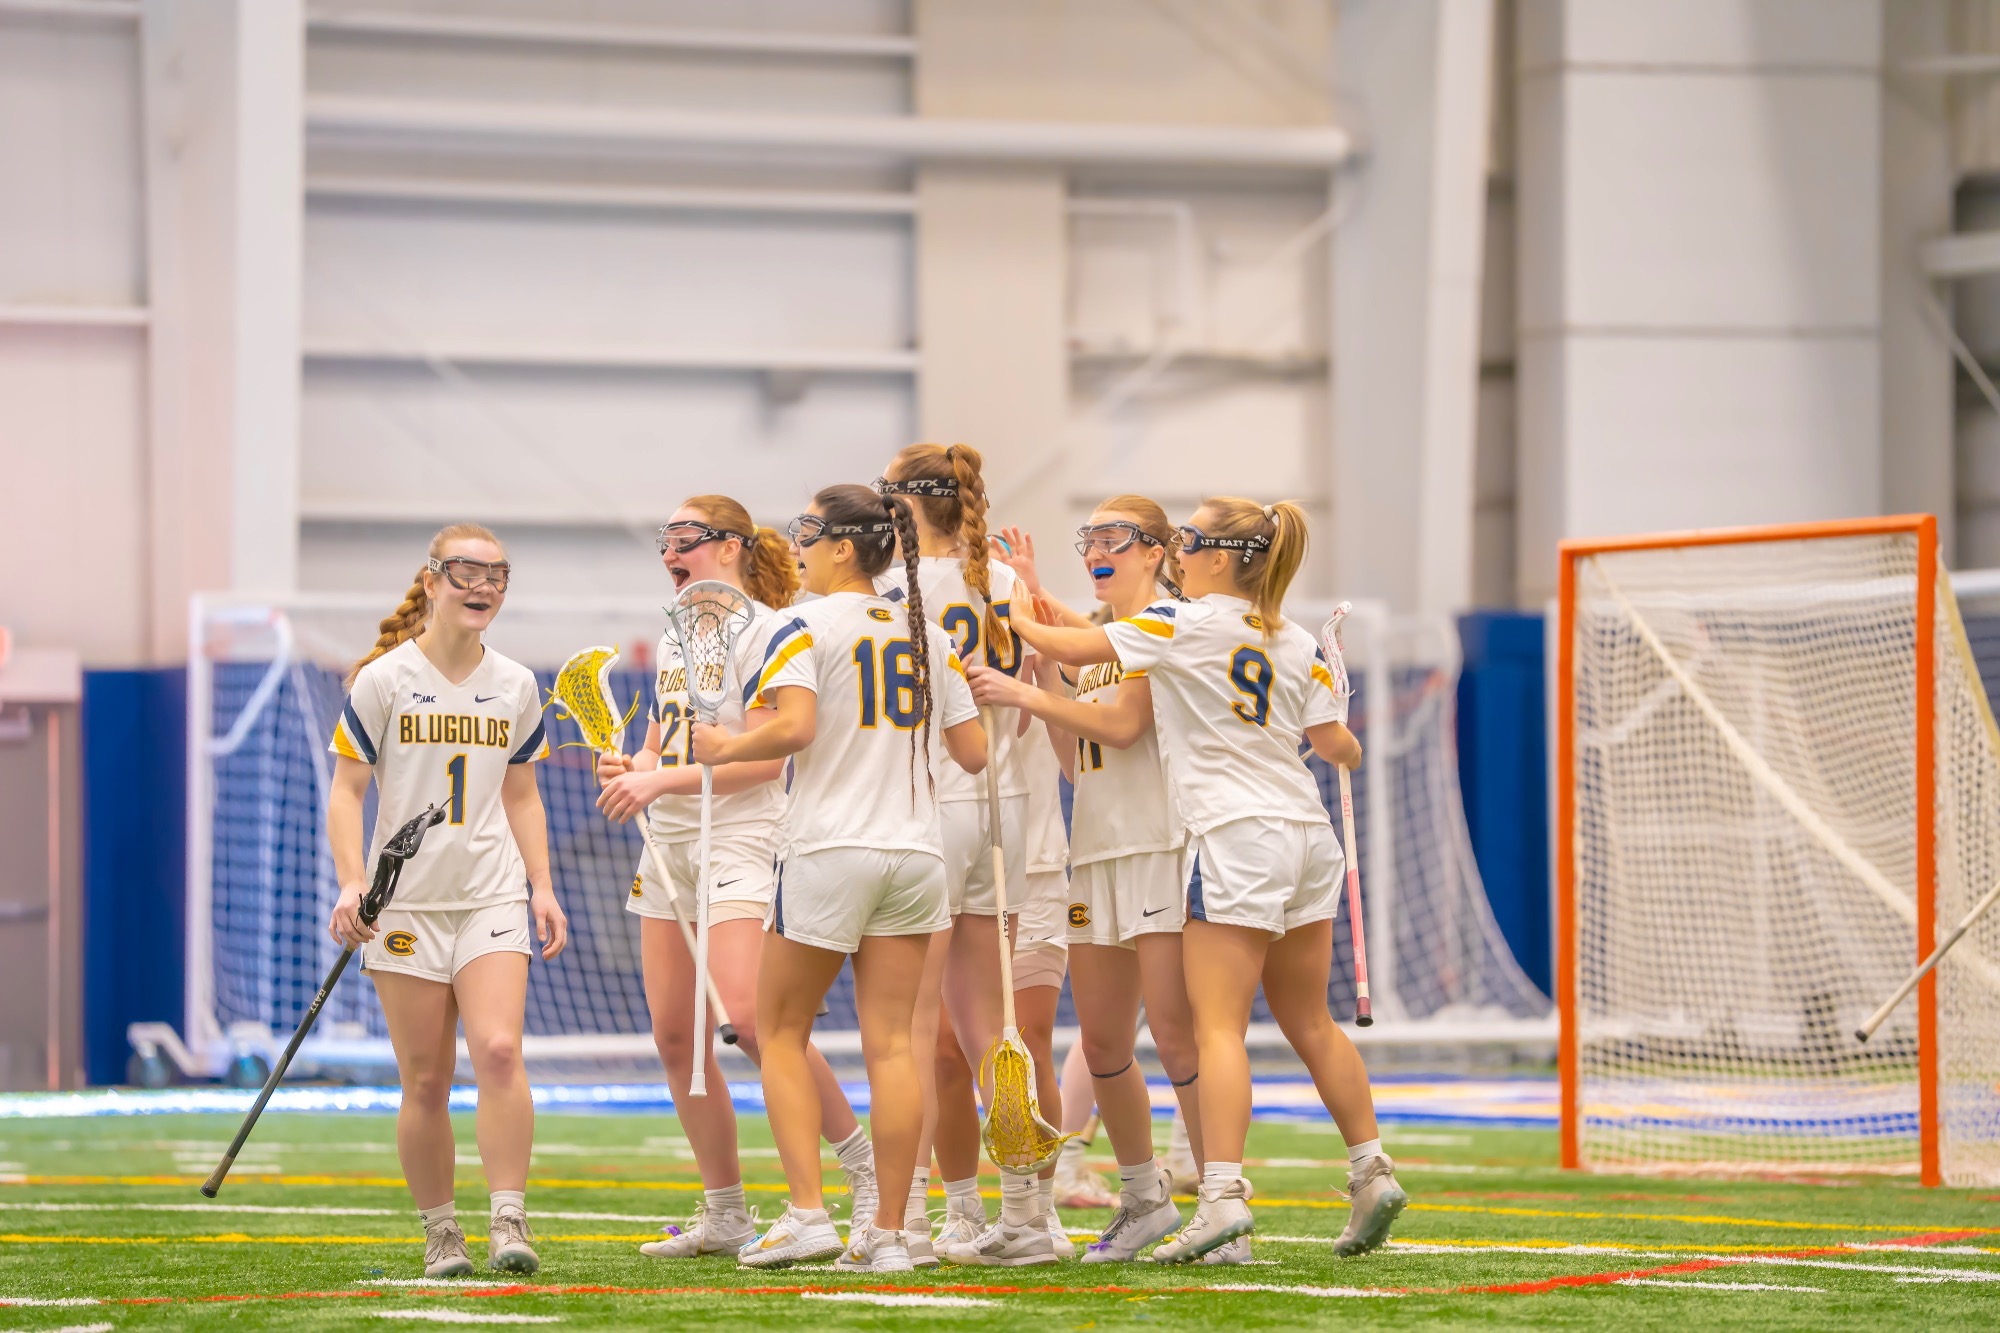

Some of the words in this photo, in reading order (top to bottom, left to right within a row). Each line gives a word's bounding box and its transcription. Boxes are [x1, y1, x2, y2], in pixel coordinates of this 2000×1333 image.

[882, 483, 899, 493] TX
[907, 479, 938, 489] STX
[831, 525, 863, 534] STX
[1255, 535, 1269, 545] AIT
[940, 600, 1023, 678] 20
[852, 637, 926, 730] 16
[1076, 661, 1123, 698] UGOLDS
[1228, 644, 1276, 727] 9
[400, 714, 510, 749] BLUGOLDS
[446, 753, 468, 825] 1
[1343, 795, 1351, 818] GAIT
[1002, 910, 1010, 939] GAIT
[310, 988, 326, 1014] GAIT
